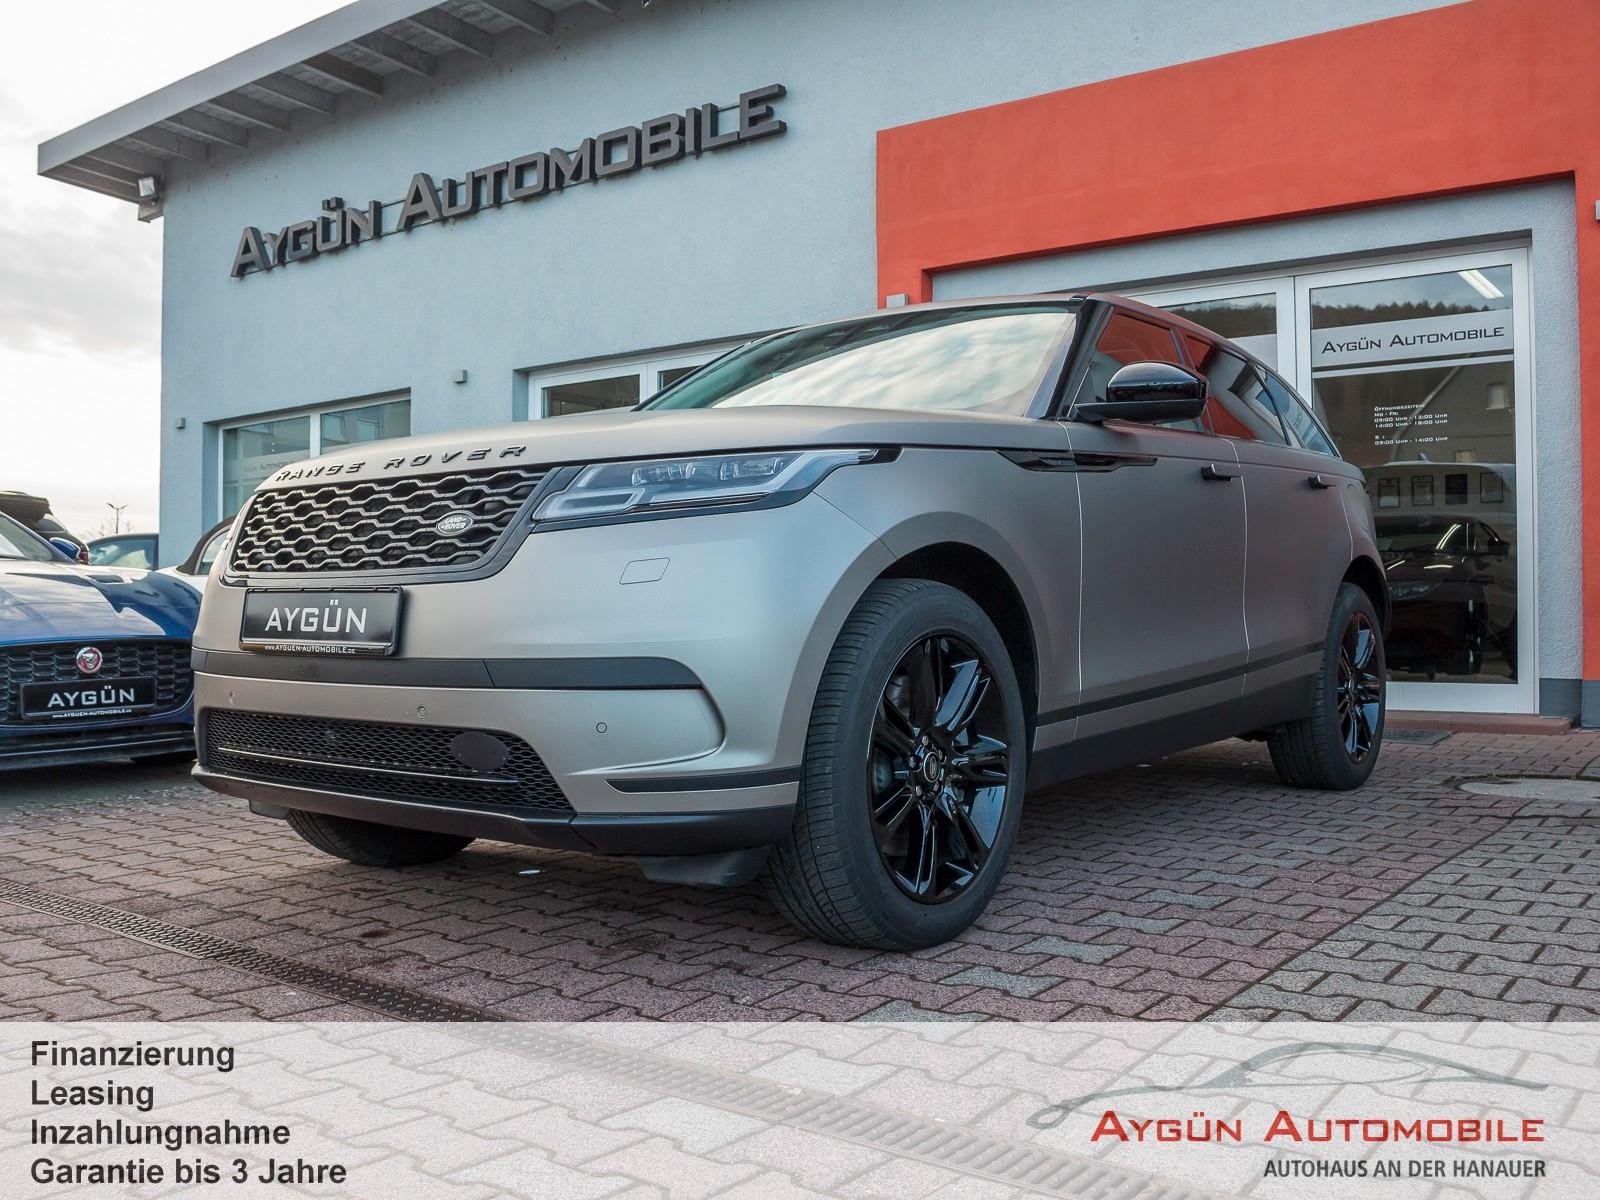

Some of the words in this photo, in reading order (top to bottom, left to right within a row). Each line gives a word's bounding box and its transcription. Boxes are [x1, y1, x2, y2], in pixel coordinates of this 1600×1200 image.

[231, 197, 384, 278] AYGÜN
[398, 84, 788, 230] AUTOMOBILE
[1321, 336, 1382, 355] AYGÜN
[1389, 326, 1505, 348] AUTOMOBILE
[275, 459, 366, 482] RANGE
[383, 444, 527, 469] ROVER
[445, 522, 467, 530] ROVER
[264, 599, 368, 634] AYGÜN
[47, 685, 135, 708] AYGÜN
